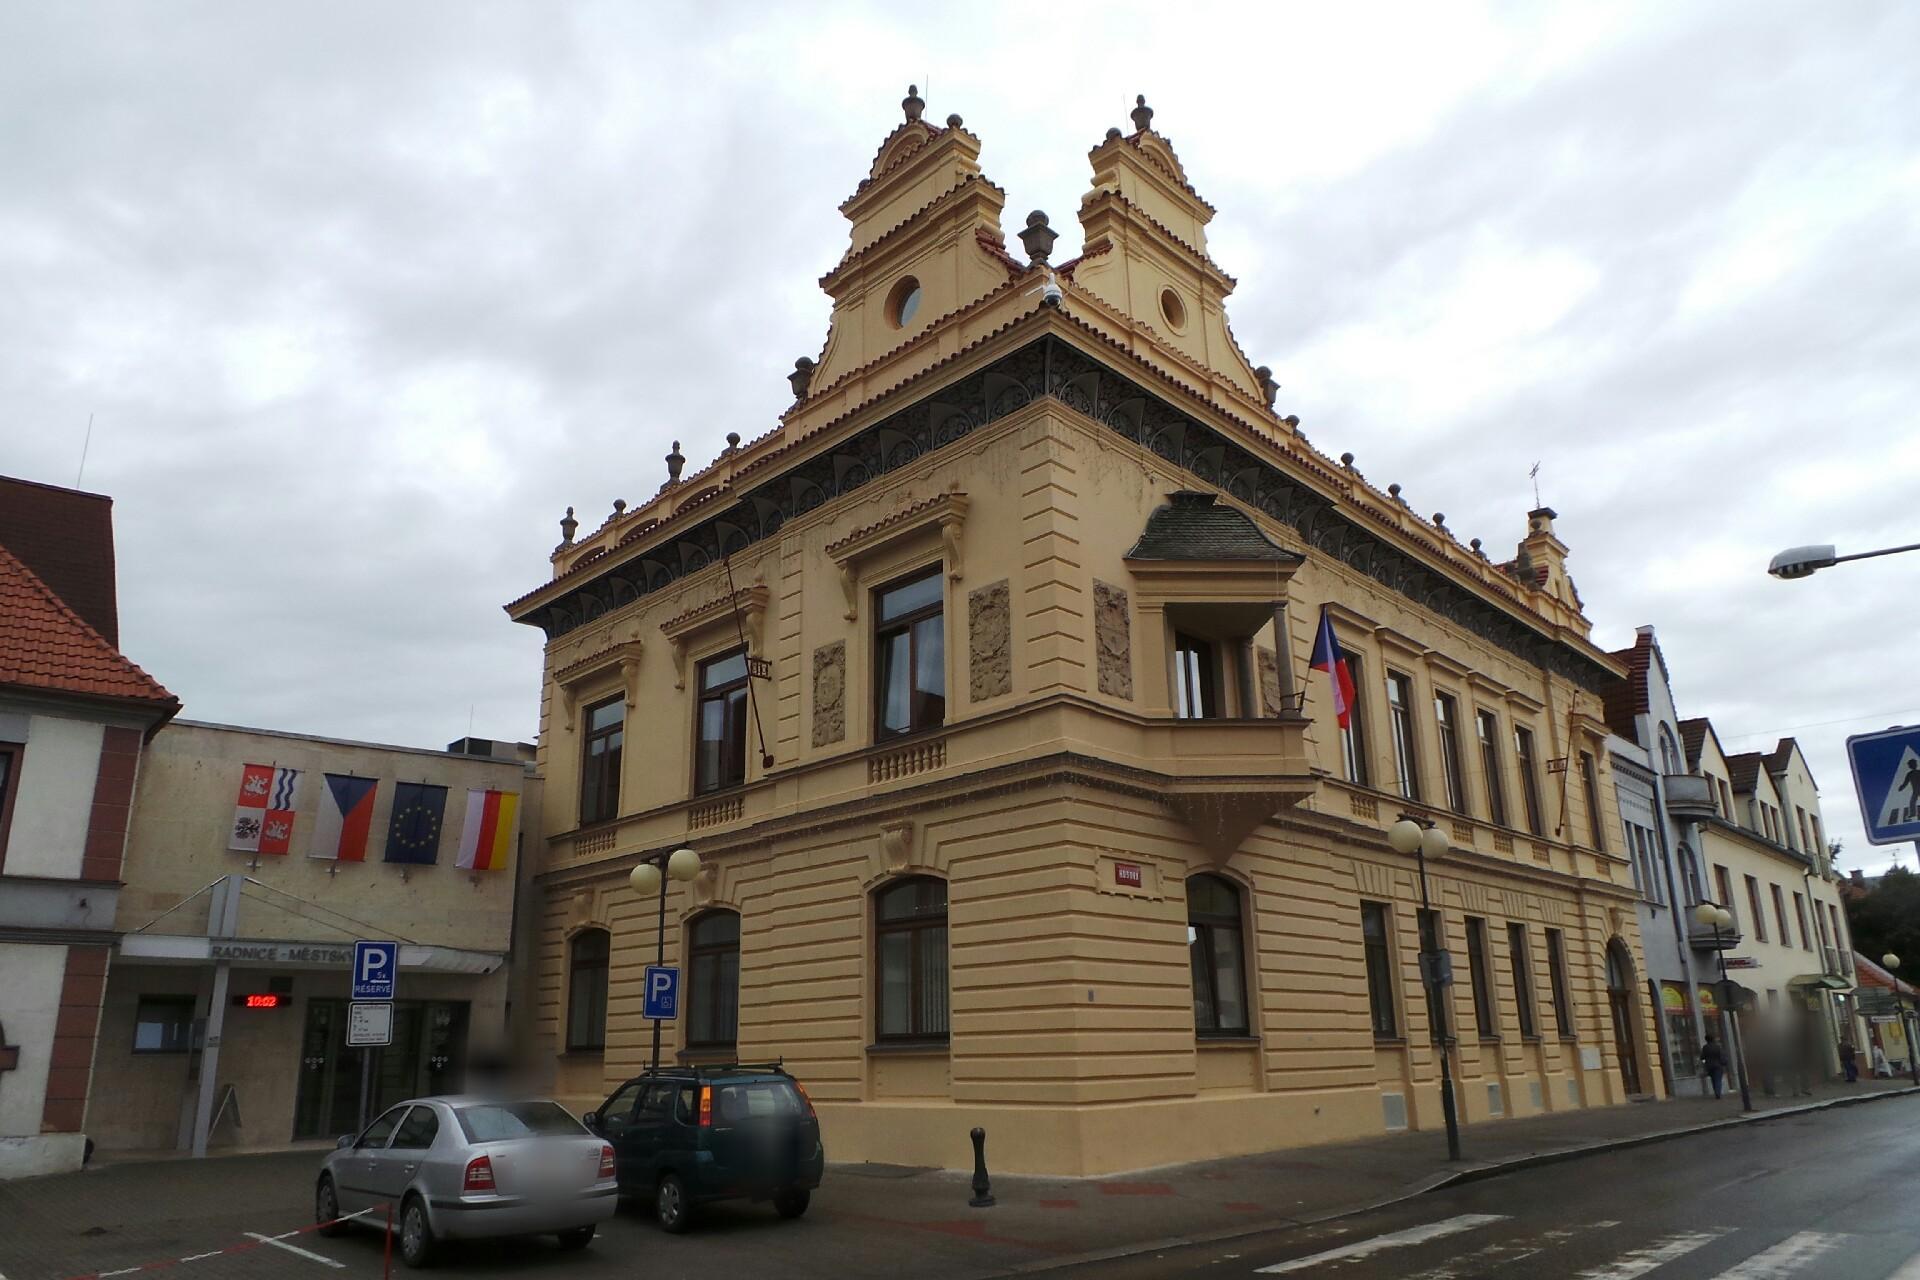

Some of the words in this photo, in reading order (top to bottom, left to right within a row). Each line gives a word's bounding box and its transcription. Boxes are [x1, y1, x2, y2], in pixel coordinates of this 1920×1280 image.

[211, 945, 278, 960] RADNICE
[362, 948, 387, 980] P
[652, 973, 672, 1002] P
[247, 995, 276, 1007] 10:02
